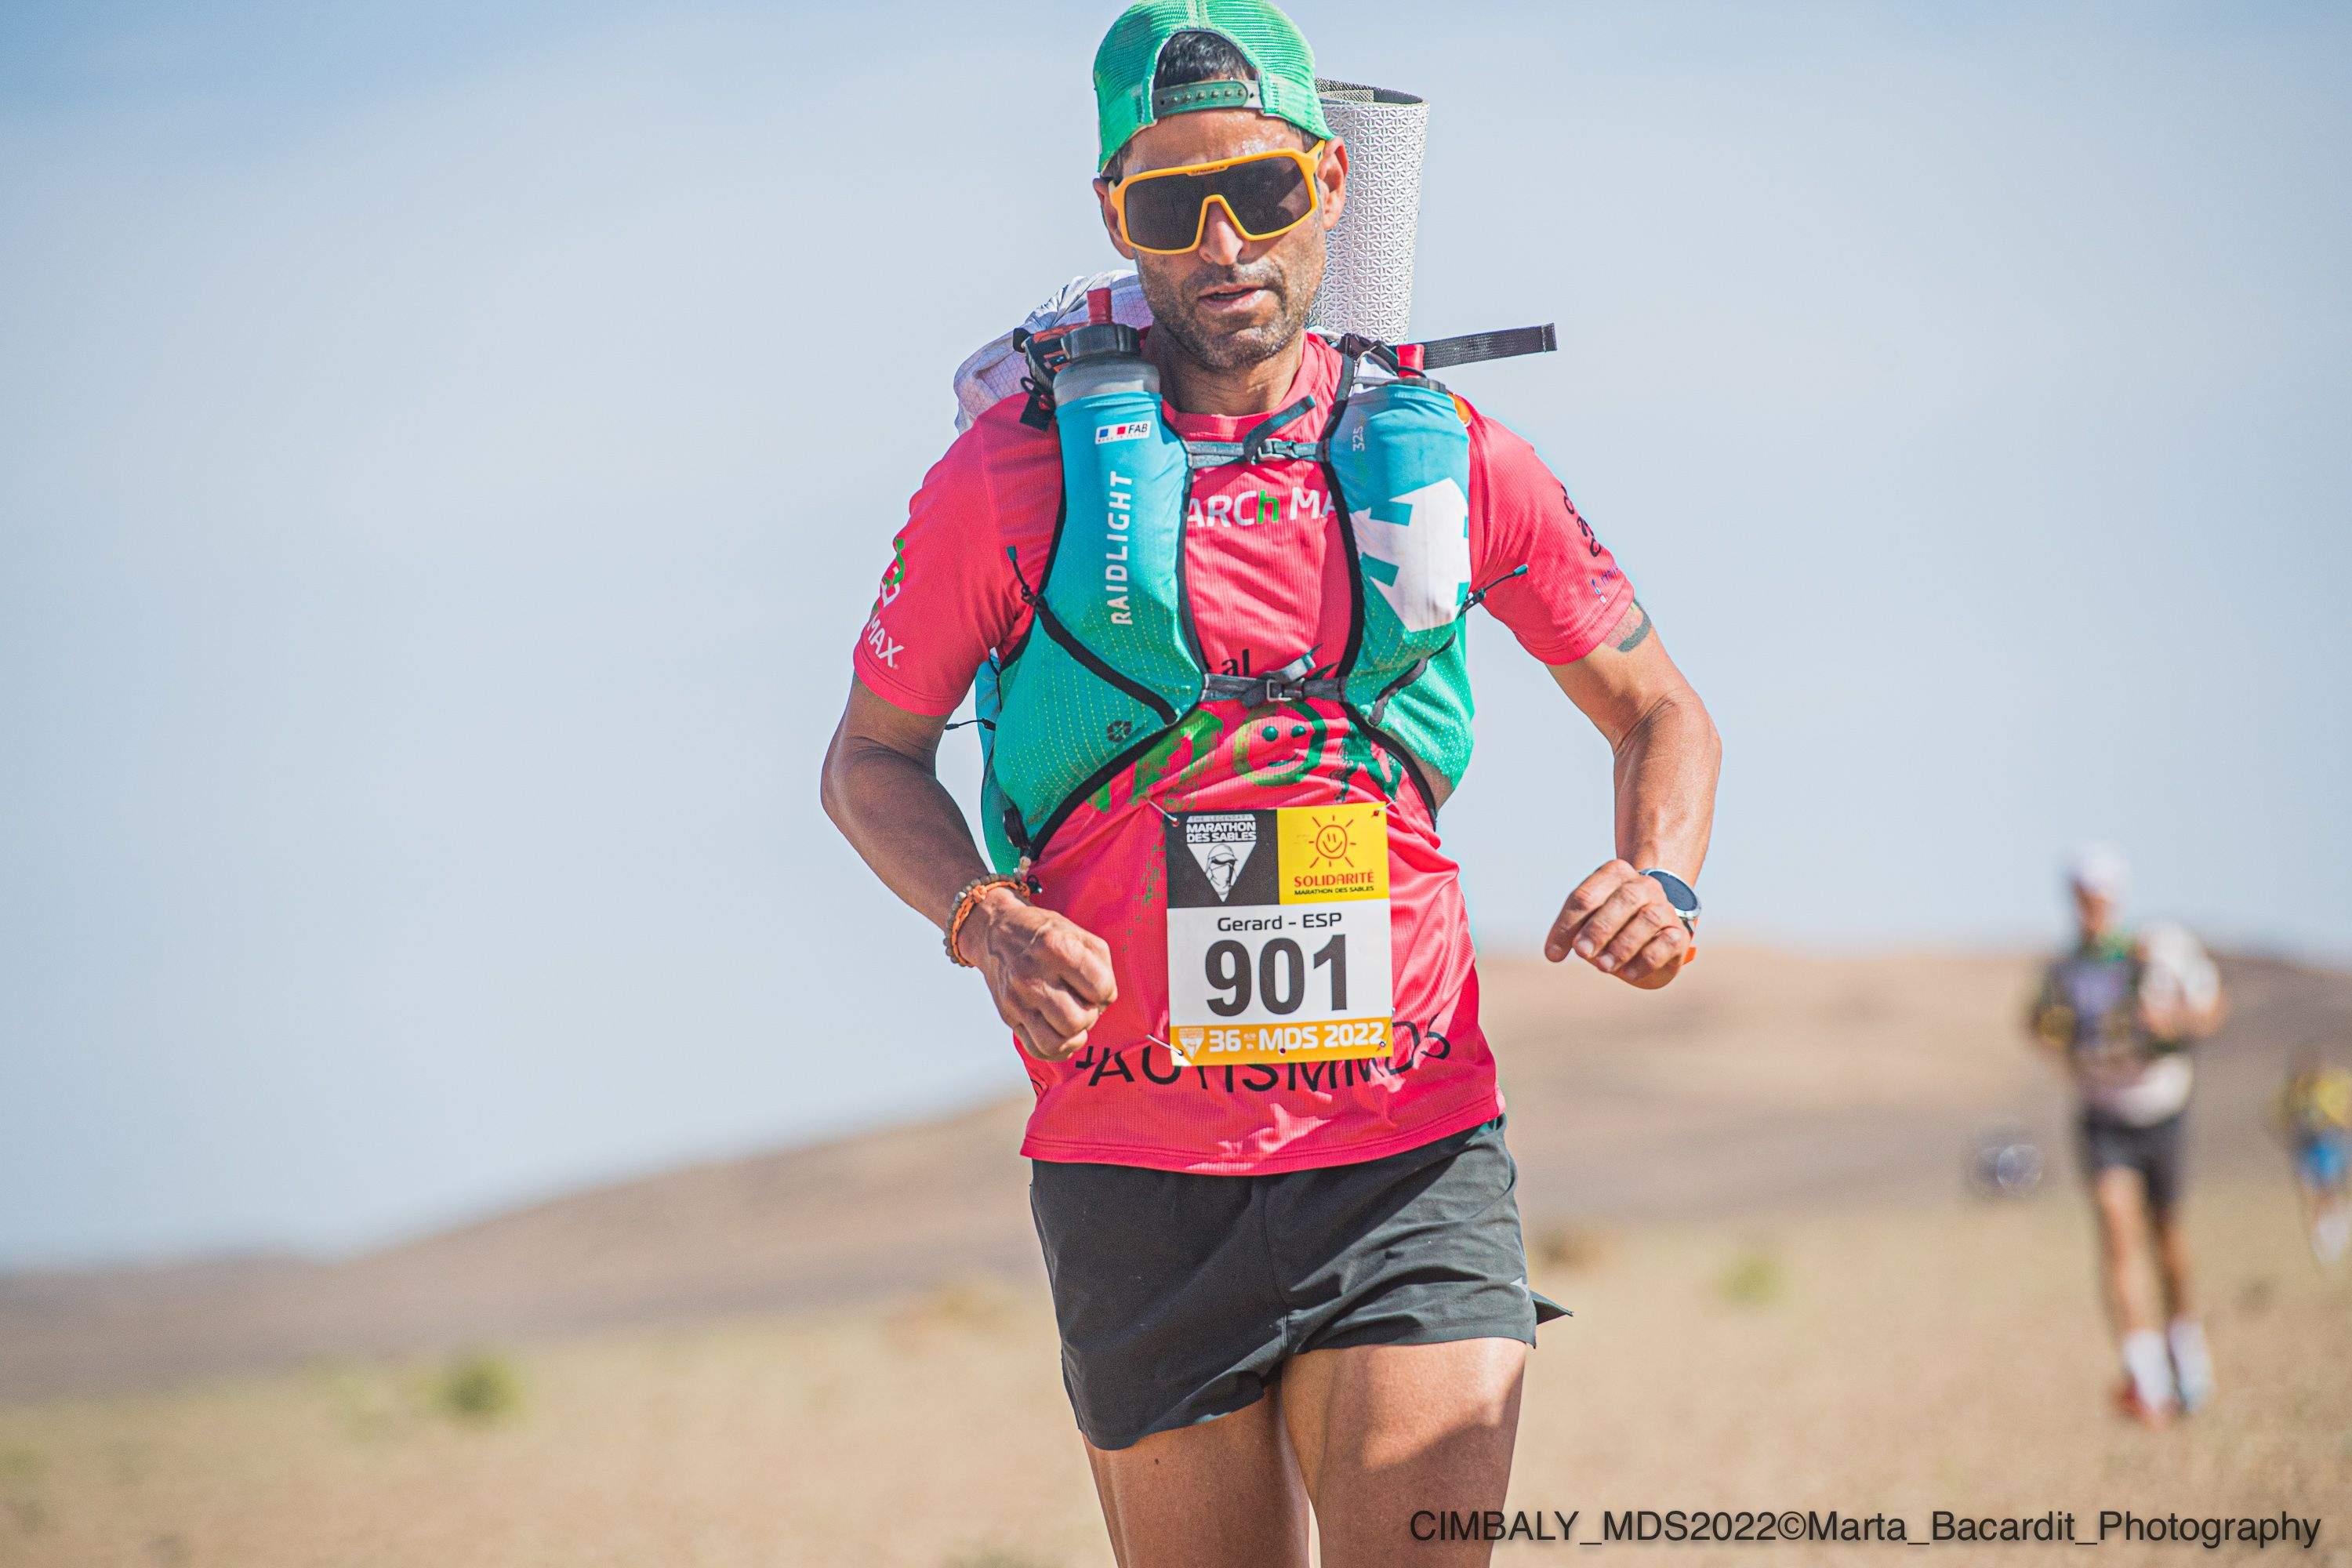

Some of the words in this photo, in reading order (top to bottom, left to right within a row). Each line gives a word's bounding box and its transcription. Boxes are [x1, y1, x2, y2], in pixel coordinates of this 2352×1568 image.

[1105, 470, 1133, 626] RAIDLIGHT
[1186, 821, 1256, 833] MARATHON
[1186, 833, 1210, 843] DES
[1211, 831, 1257, 842] SABLES
[1294, 869, 1374, 887] SOLIDARITÉ
[1218, 916, 1282, 931] Gerard
[1303, 913, 1342, 928] ESP
[1205, 934, 1347, 1017] 901
[1209, 1029, 1241, 1053] 36
[1258, 1025, 1319, 1051] MDS
[1323, 1022, 1385, 1048] 2022
